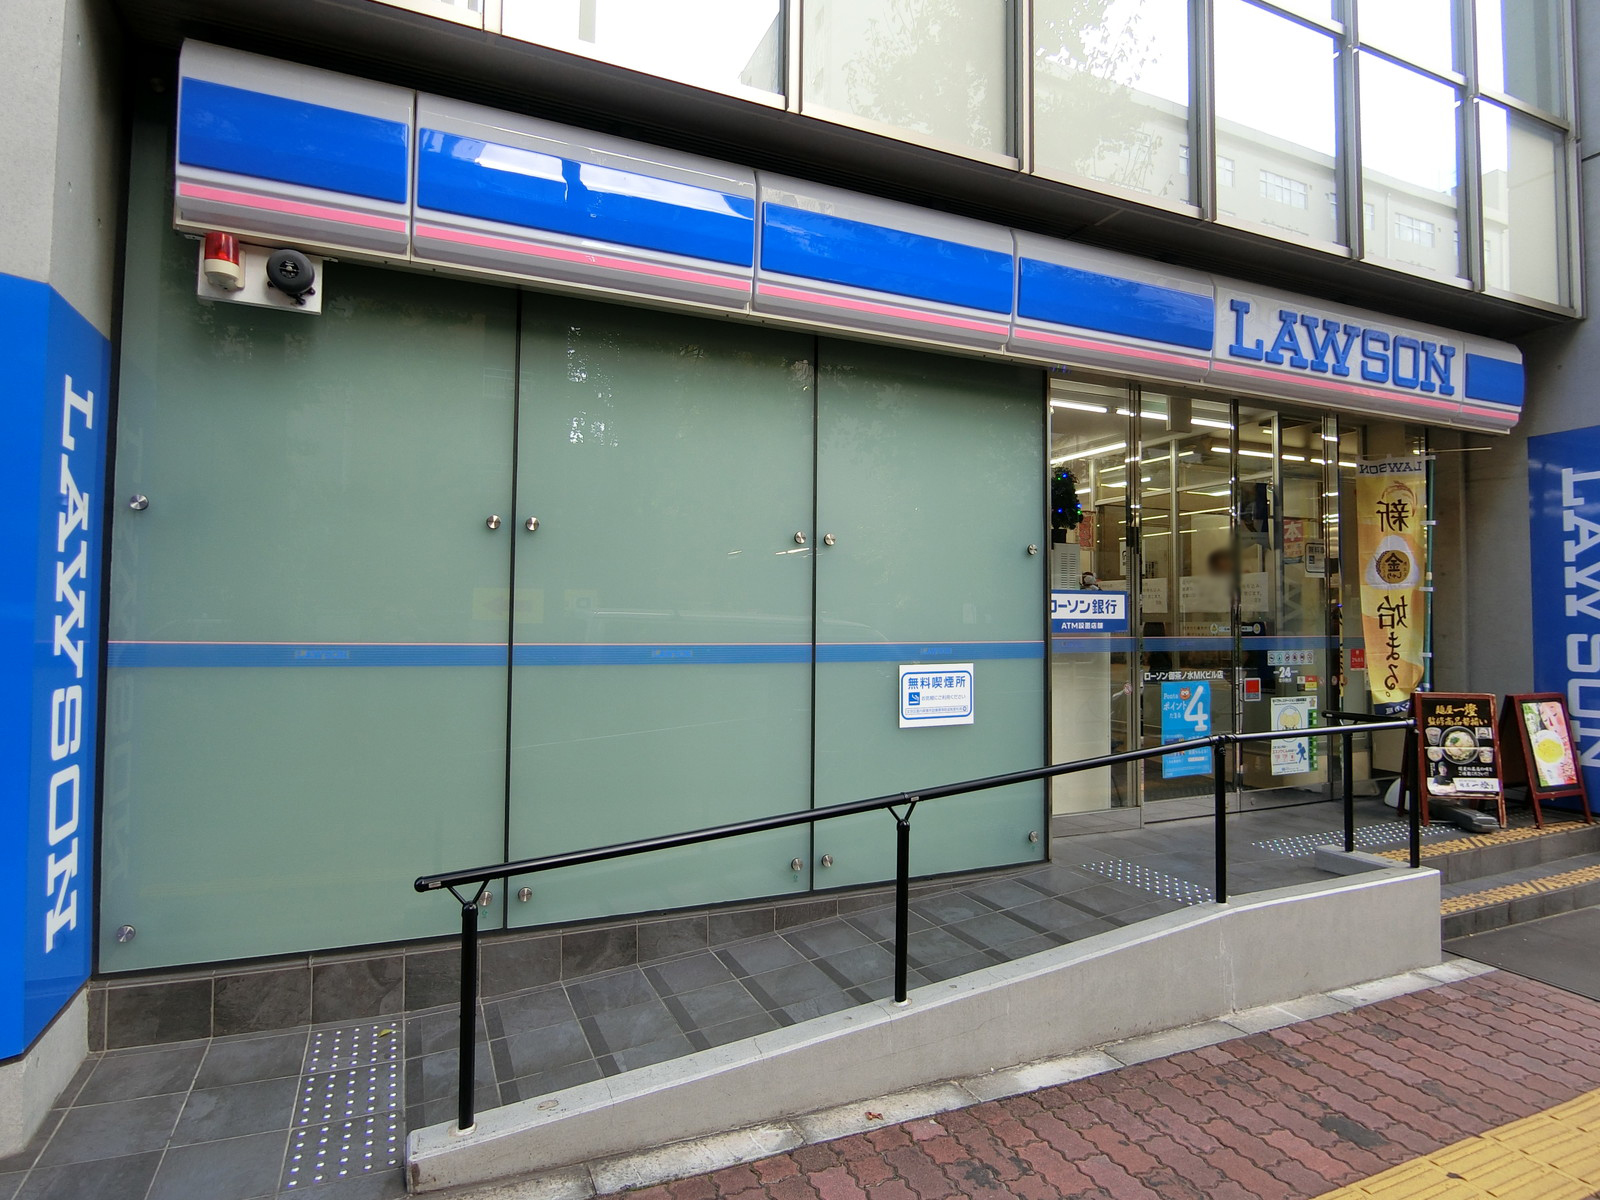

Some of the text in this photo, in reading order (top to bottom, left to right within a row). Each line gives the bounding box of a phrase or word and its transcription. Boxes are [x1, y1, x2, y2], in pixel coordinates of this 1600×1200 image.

[1228, 298, 1456, 396] LAWSON
[45, 374, 94, 954] LAWSON
[1144, 670, 1224, 681] ローソン御茶ノ水MKビル店
[1279, 666, 1291, 678] 24
[908, 676, 966, 690] 無料喫煙所
[1163, 701, 1187, 711] ポイント
[1184, 685, 1209, 732] 4
